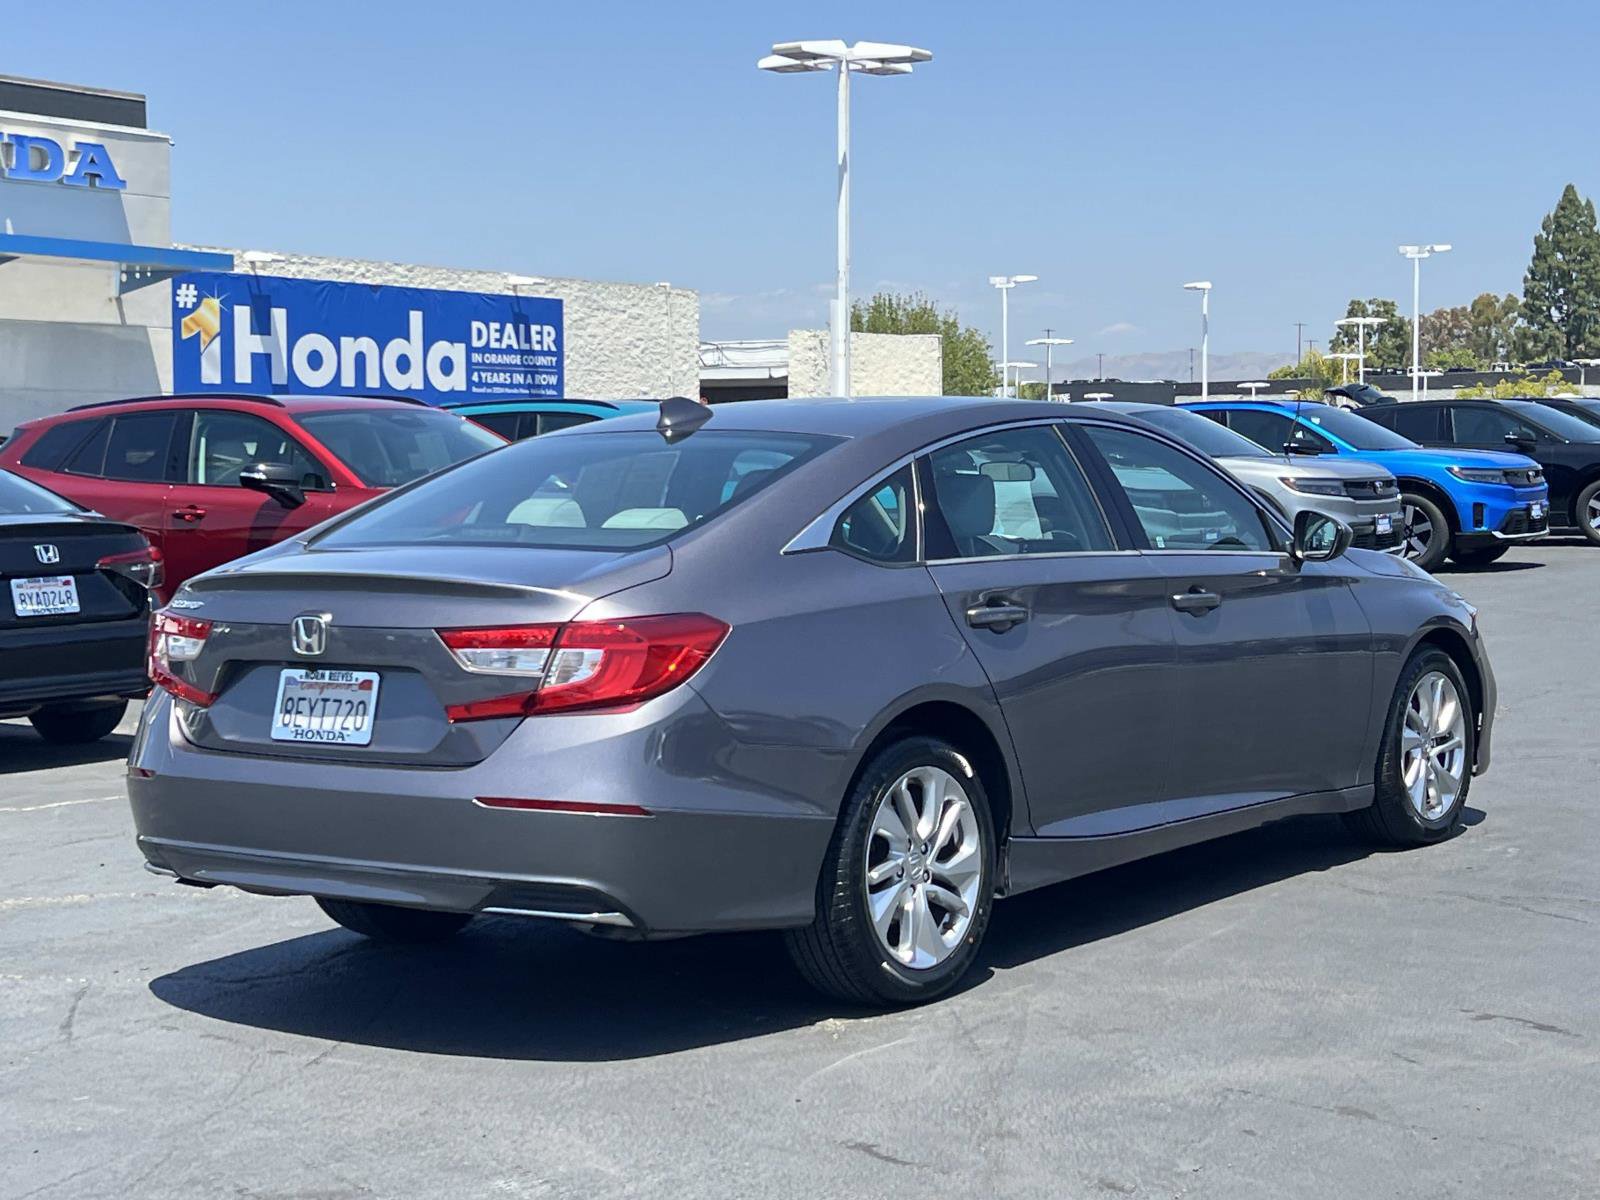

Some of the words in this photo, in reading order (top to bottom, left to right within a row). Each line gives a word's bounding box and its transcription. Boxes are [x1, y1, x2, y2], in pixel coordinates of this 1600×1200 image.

[0, 132, 127, 189] DA
[233, 305, 467, 392] Honda
[471, 320, 557, 351] DEALER
[471, 352, 482, 363] IN
[484, 354, 521, 365] ORANGE
[523, 355, 558, 367] COUNTY
[471, 371, 479, 383] 4
[480, 371, 511, 384] YEARS
[512, 373, 524, 385] IN
[525, 374, 533, 385] A
[535, 374, 558, 386] ROW
[282, 697, 367, 731] 8EYT720
[293, 729, 346, 741] HONDA
